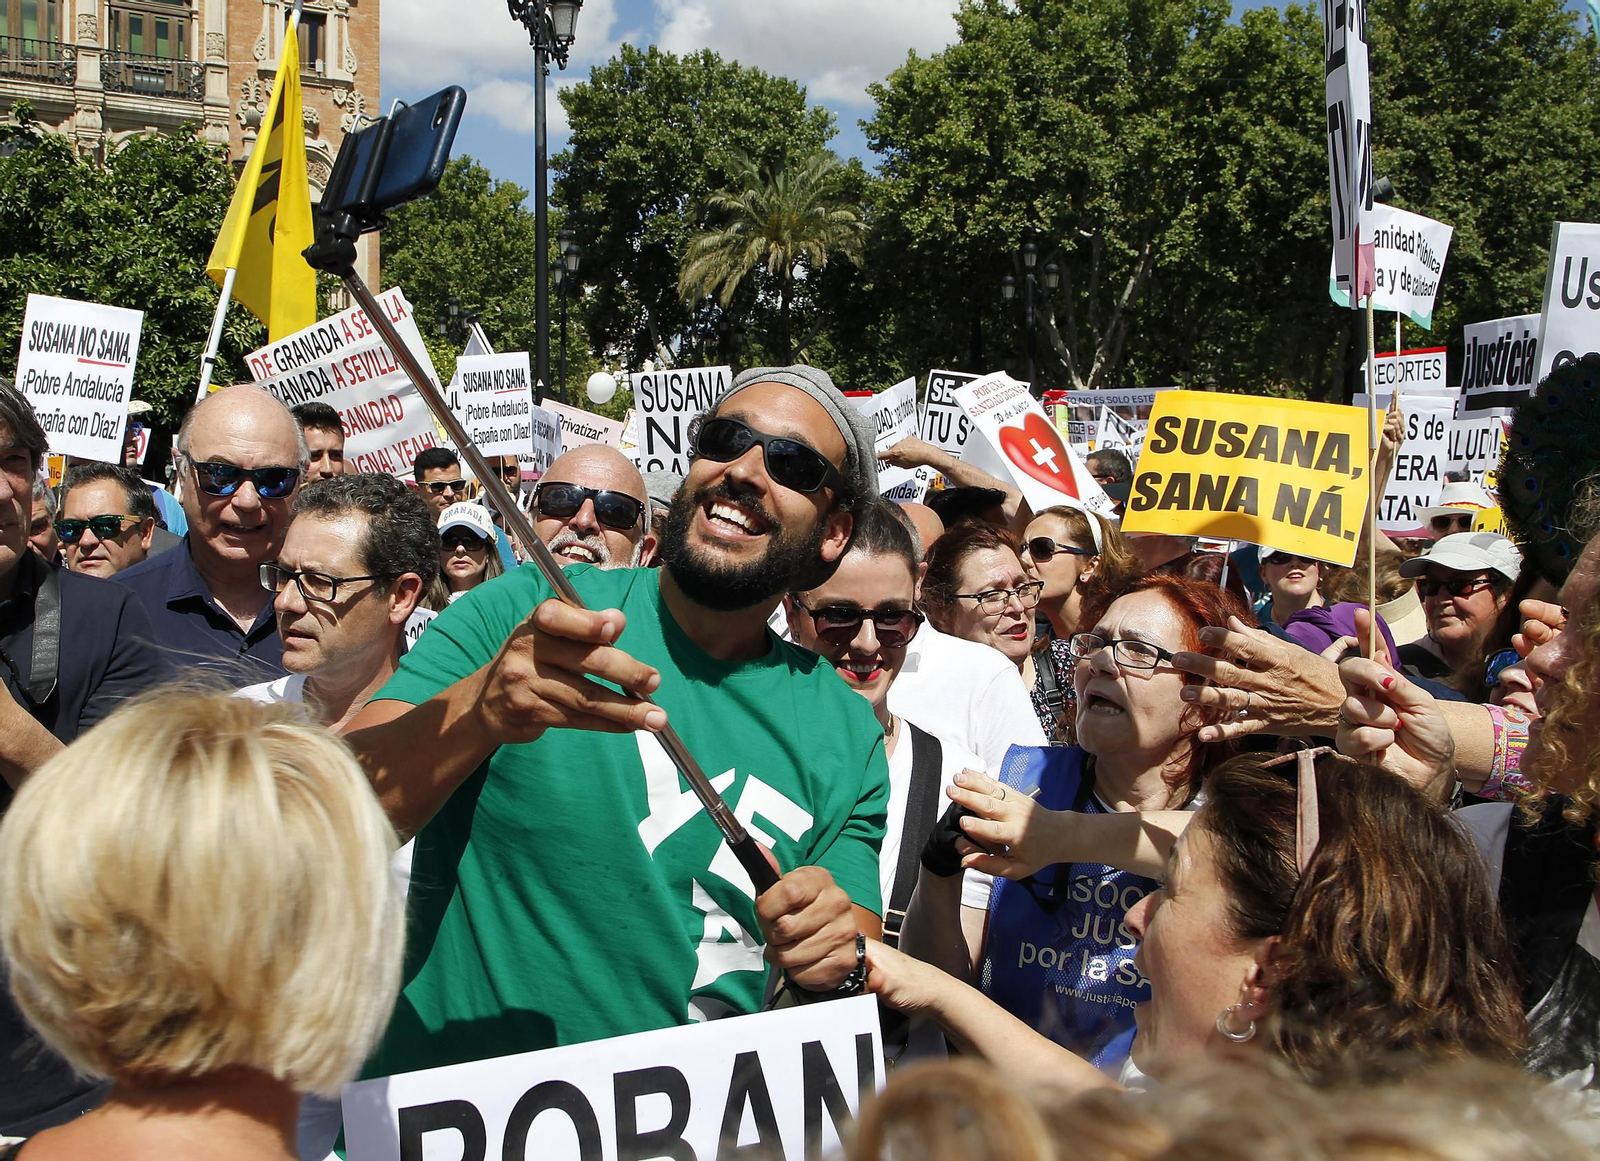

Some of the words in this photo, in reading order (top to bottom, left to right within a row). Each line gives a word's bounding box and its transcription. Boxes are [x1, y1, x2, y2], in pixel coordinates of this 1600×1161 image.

[1374, 225, 1414, 254] anidad
[1416, 231, 1440, 275] Pública
[1389, 269, 1397, 295] y
[1400, 265, 1411, 293] de
[29, 320, 76, 354] SUSANA
[77, 326, 97, 357] NO
[97, 329, 131, 364] SANA.
[250, 353, 276, 380] DE
[273, 323, 344, 372] GRANADA
[340, 318, 356, 344] A
[22, 368, 61, 395] ¡Pobre
[62, 371, 124, 403] Andalucía
[263, 366, 336, 406] RANADA
[331, 362, 347, 389] A
[463, 367, 493, 394] SUSANA
[494, 369, 505, 391] NO
[505, 367, 528, 390] SANA.
[640, 371, 726, 413] SUSANA
[930, 378, 955, 403] SE
[972, 383, 992, 399] POR
[988, 379, 1006, 392] UNA
[465, 404, 490, 426] ¡Pobre
[491, 398, 529, 418] Andalucía
[968, 392, 1005, 417] SANIDAD
[1002, 385, 1027, 402] DIGNA
[1079, 396, 1092, 405] NO
[1094, 396, 1105, 405] ES
[1107, 396, 1130, 404] SOLO
[1132, 394, 1155, 404] ESTÉ
[68, 414, 89, 437] con
[90, 411, 120, 440] Díaz!
[340, 394, 404, 438] SANIDAD
[928, 410, 952, 443] TU
[1424, 413, 1444, 441] de
[474, 427, 498, 449] España
[500, 429, 512, 442] con
[513, 421, 531, 440] Díaz!
[1150, 415, 1363, 480] SUSANA,
[443, 506, 483, 524] GRANADA
[1130, 471, 1259, 516] SANA
[1271, 483, 1356, 542] NÁ.
[1018, 942, 1072, 971] por
[1082, 949, 1108, 983] la
